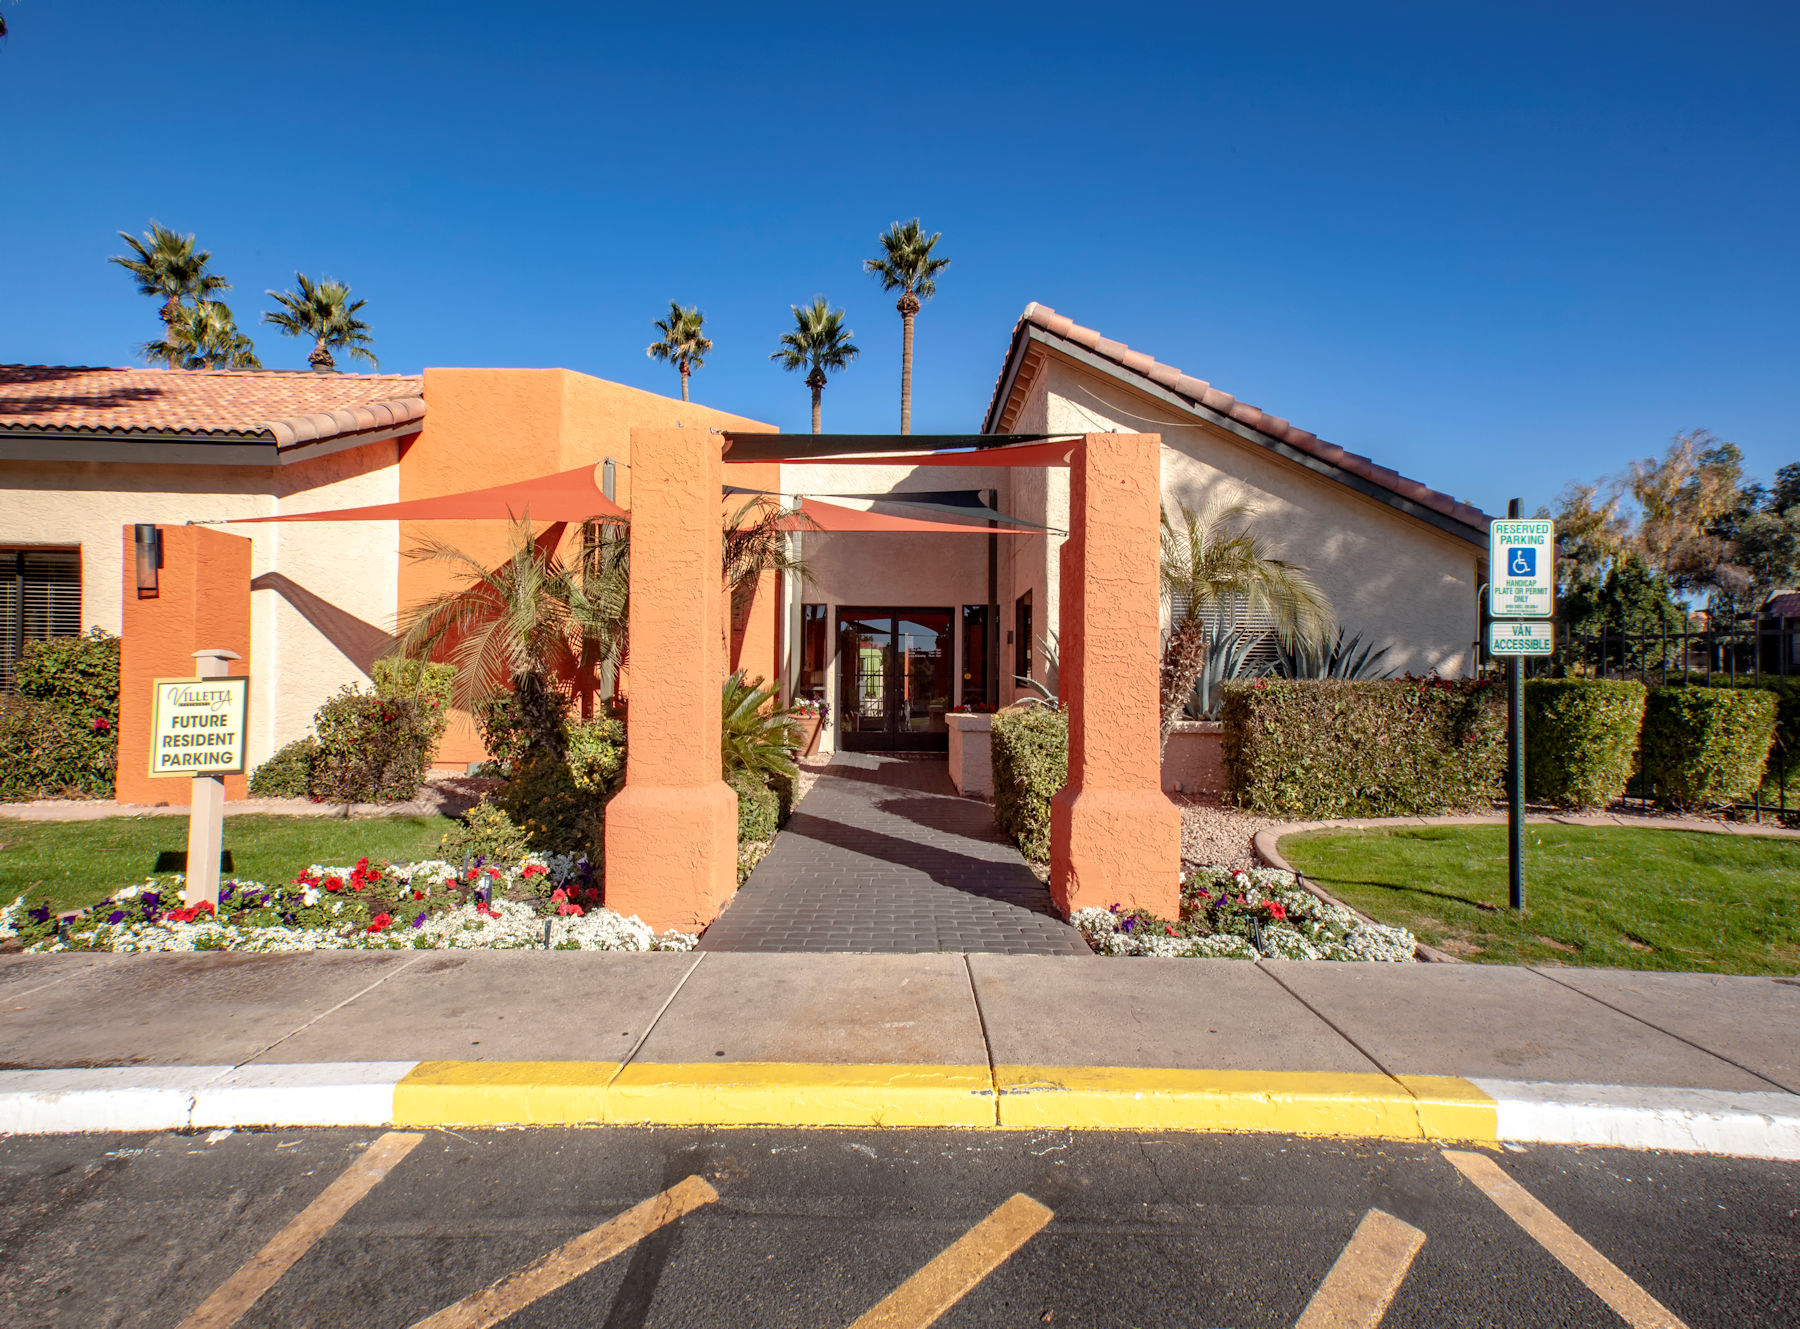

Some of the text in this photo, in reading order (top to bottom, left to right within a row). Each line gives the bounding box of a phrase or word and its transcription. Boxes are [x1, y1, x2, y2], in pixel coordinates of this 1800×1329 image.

[1496, 524, 1549, 534] RESERVED
[1500, 535, 1545, 545] PARKING
[1505, 579, 1537, 587] HANDICAP
[1495, 587, 1548, 595] PLATE OR PERMIT
[1513, 595, 1529, 603] ONLY
[1512, 626, 1532, 636] VAN
[1494, 639, 1550, 650] ACCESSIBLE
[167, 686, 233, 712] VILLETTA
[172, 714, 228, 729] FUTURE
[163, 732, 235, 748] RESIDENT
[162, 751, 233, 767] PARKING
